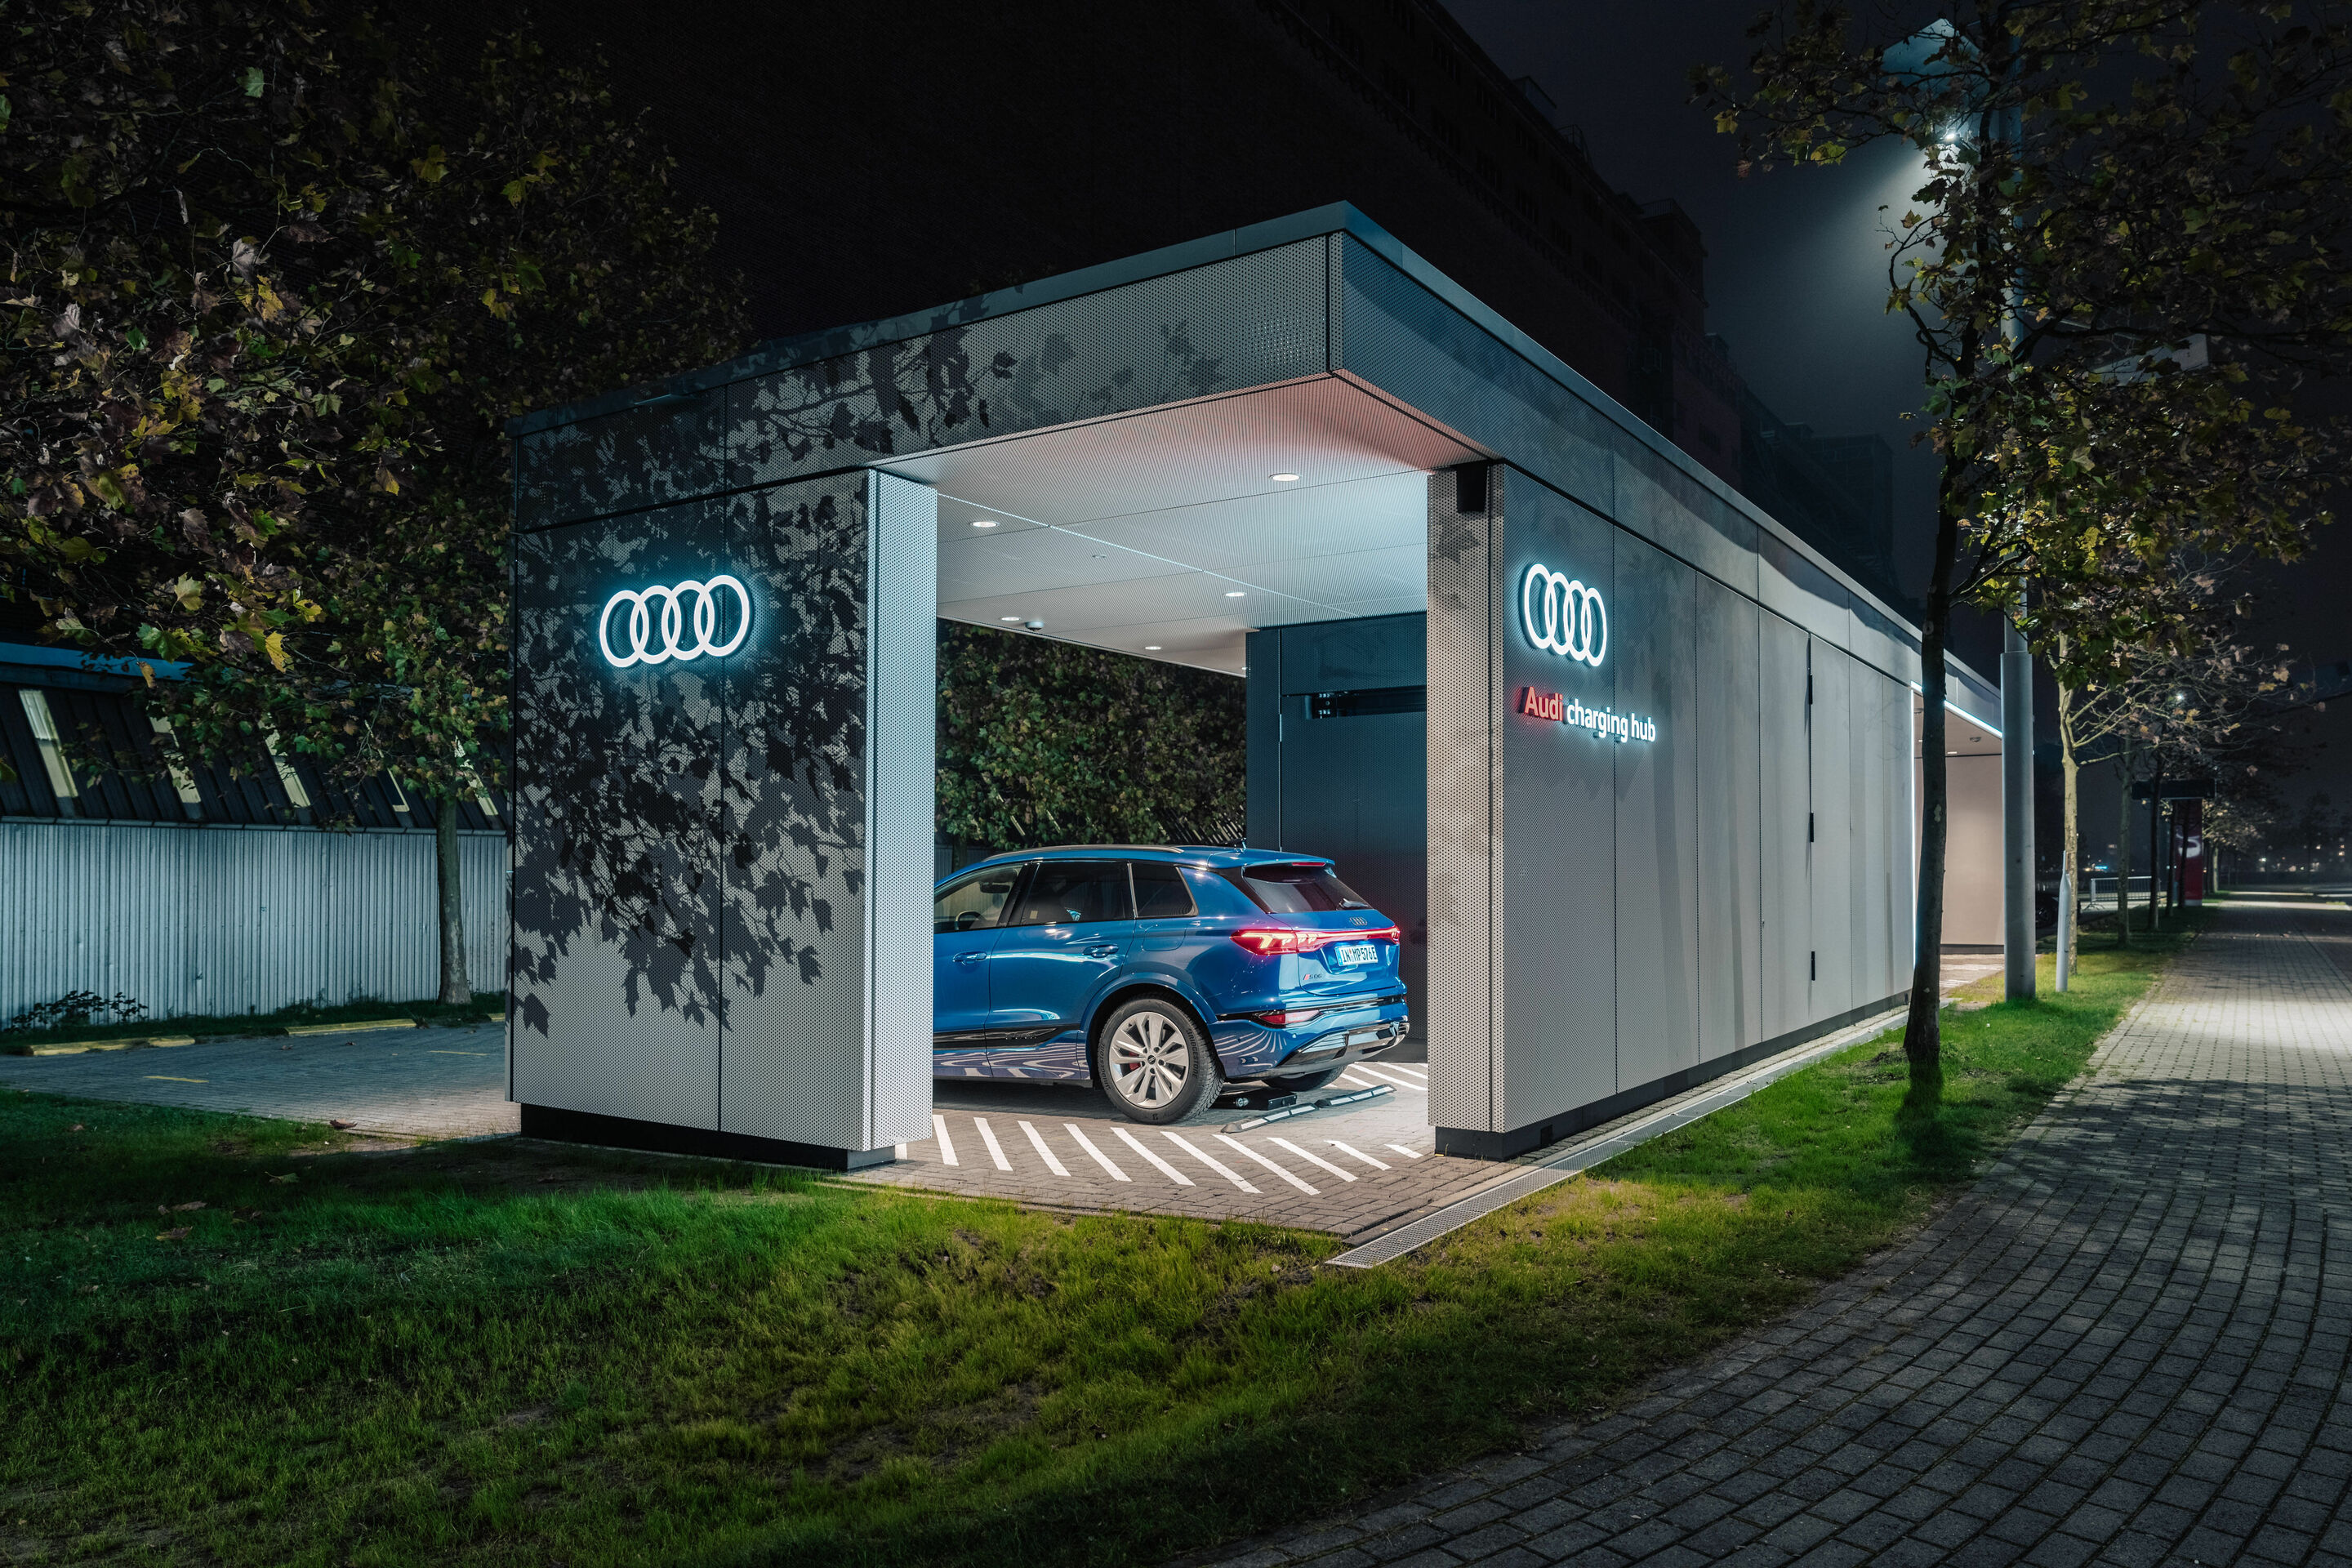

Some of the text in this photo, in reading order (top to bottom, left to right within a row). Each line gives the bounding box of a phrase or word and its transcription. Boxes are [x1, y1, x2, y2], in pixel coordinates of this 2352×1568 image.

[1523, 686, 1656, 743] Audi charging hub
[1341, 949, 1352, 963] IN
